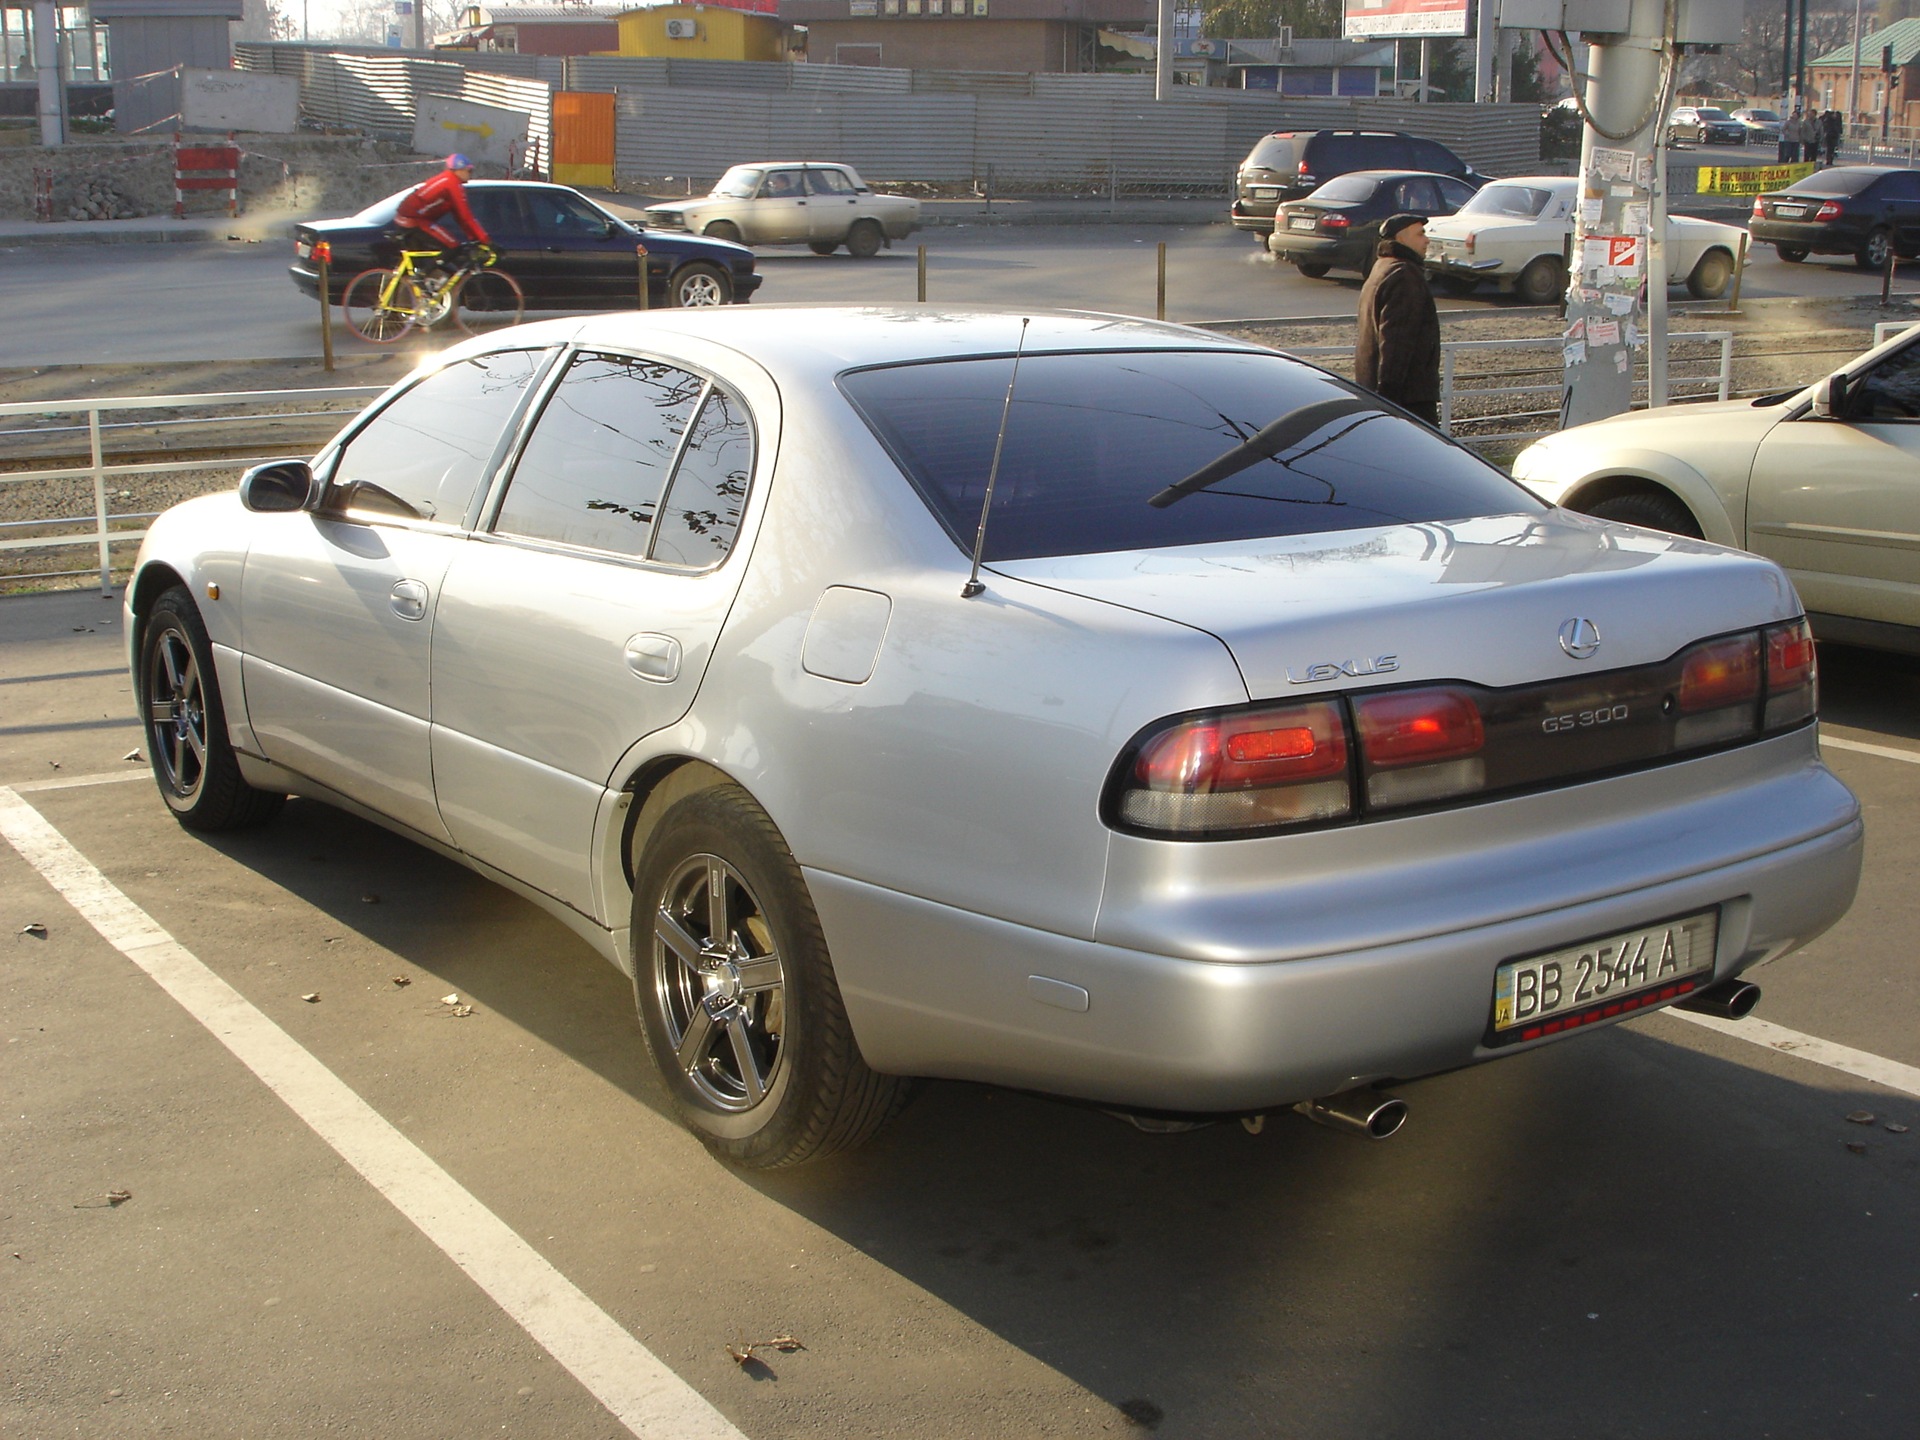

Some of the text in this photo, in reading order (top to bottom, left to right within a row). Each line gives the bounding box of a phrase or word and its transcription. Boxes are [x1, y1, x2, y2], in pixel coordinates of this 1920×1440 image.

[1285, 654, 1400, 685] LEXUS
[1542, 705, 1629, 733] GS 300
[1512, 921, 1703, 1020] BB 2544 AT
